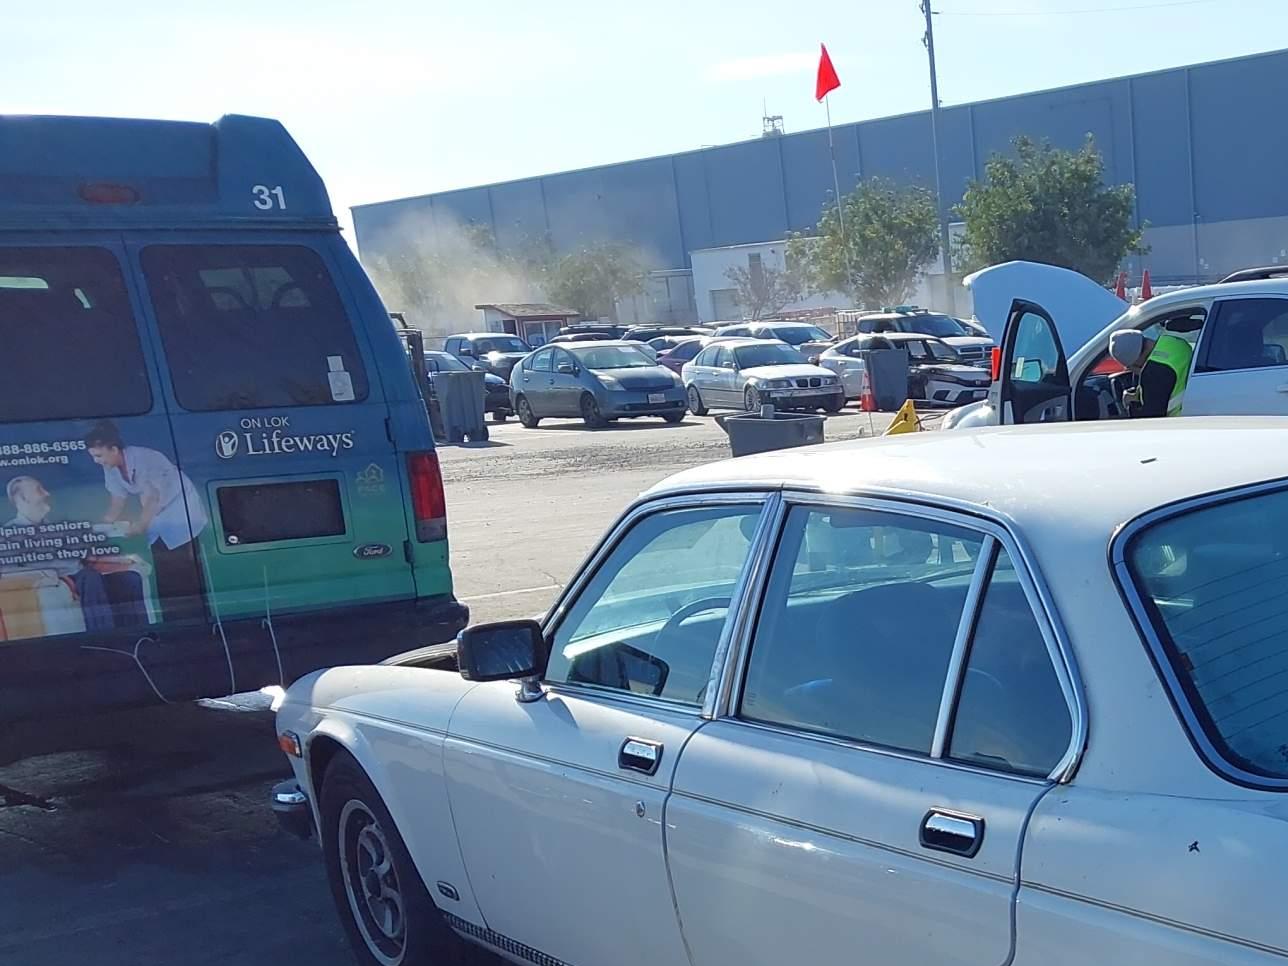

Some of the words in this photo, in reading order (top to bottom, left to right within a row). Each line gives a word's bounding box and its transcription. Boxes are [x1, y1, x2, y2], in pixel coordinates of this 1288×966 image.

[252, 185, 286, 210] 31
[240, 417, 262, 429] ON
[264, 416, 290, 428] LOK
[243, 429, 354, 457] Lifeways
[39, 521, 91, 533] seniors
[24, 537, 63, 549] living
[66, 535, 79, 545] in
[82, 533, 106, 544] the
[57, 549, 88, 559] they
[91, 546, 120, 556] love
